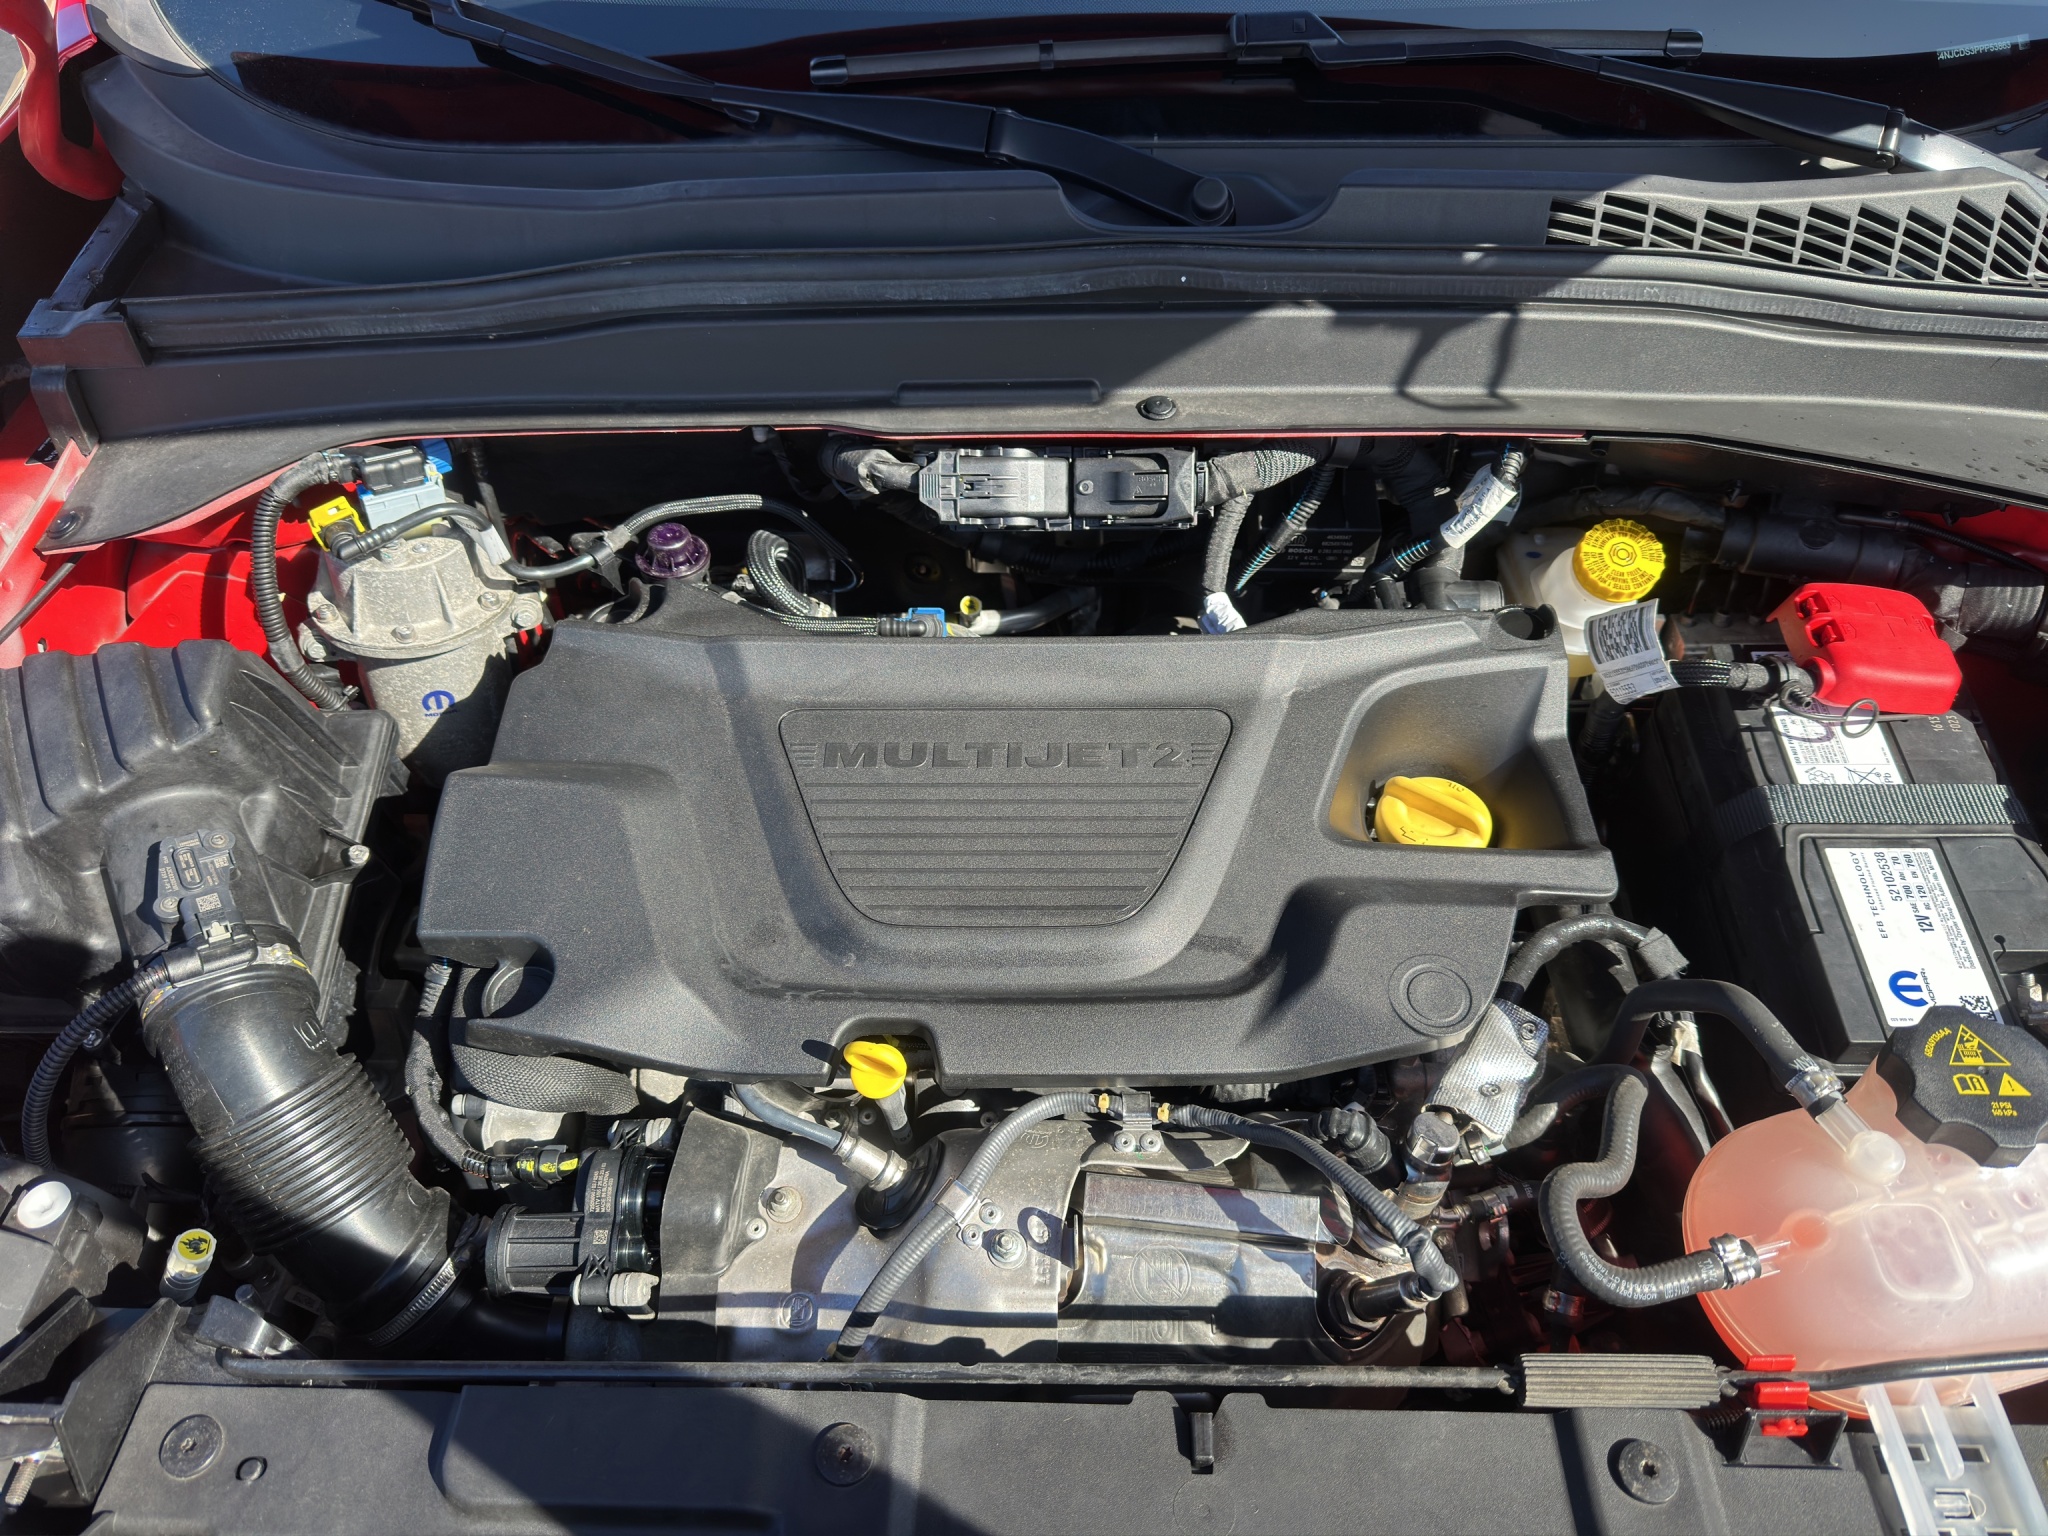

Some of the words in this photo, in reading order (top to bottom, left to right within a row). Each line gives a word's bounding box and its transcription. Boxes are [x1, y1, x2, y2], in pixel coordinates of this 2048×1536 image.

[1606, 573, 1629, 584] REMOVING
[1639, 570, 1650, 581] ONLY
[1611, 569, 1625, 577] CLEAR
[1627, 567, 1643, 577] FILLER
[1596, 573, 1608, 585] FROM
[1612, 583, 1631, 591] SEALED
[1632, 573, 1656, 590] CONTAINER
[1933, 713, 1943, 731] 1613
[1951, 714, 1963, 733] F023
[1890, 856, 1902, 865] 70
[1902, 854, 1915, 867] 760
[1872, 851, 1903, 901] 52102538
[1897, 871, 1906, 880] Ahr
[1847, 851, 1881, 916] TECHNOLOGY
[1901, 884, 1915, 898] 700
[1914, 885, 1928, 898] 120
[1909, 902, 1919, 913] SAE
[1922, 902, 1932, 910] RC
[1874, 920, 1889, 938] EFB
[1913, 914, 1935, 932] 12V
[1919, 969, 1937, 1007] MOPAR
[1991, 1101, 1999, 1109] 21
[1999, 1101, 2012, 1109] PSI
[2003, 1109, 2018, 1117] kPa
[1633, 1292, 1657, 1300] MOPAR
